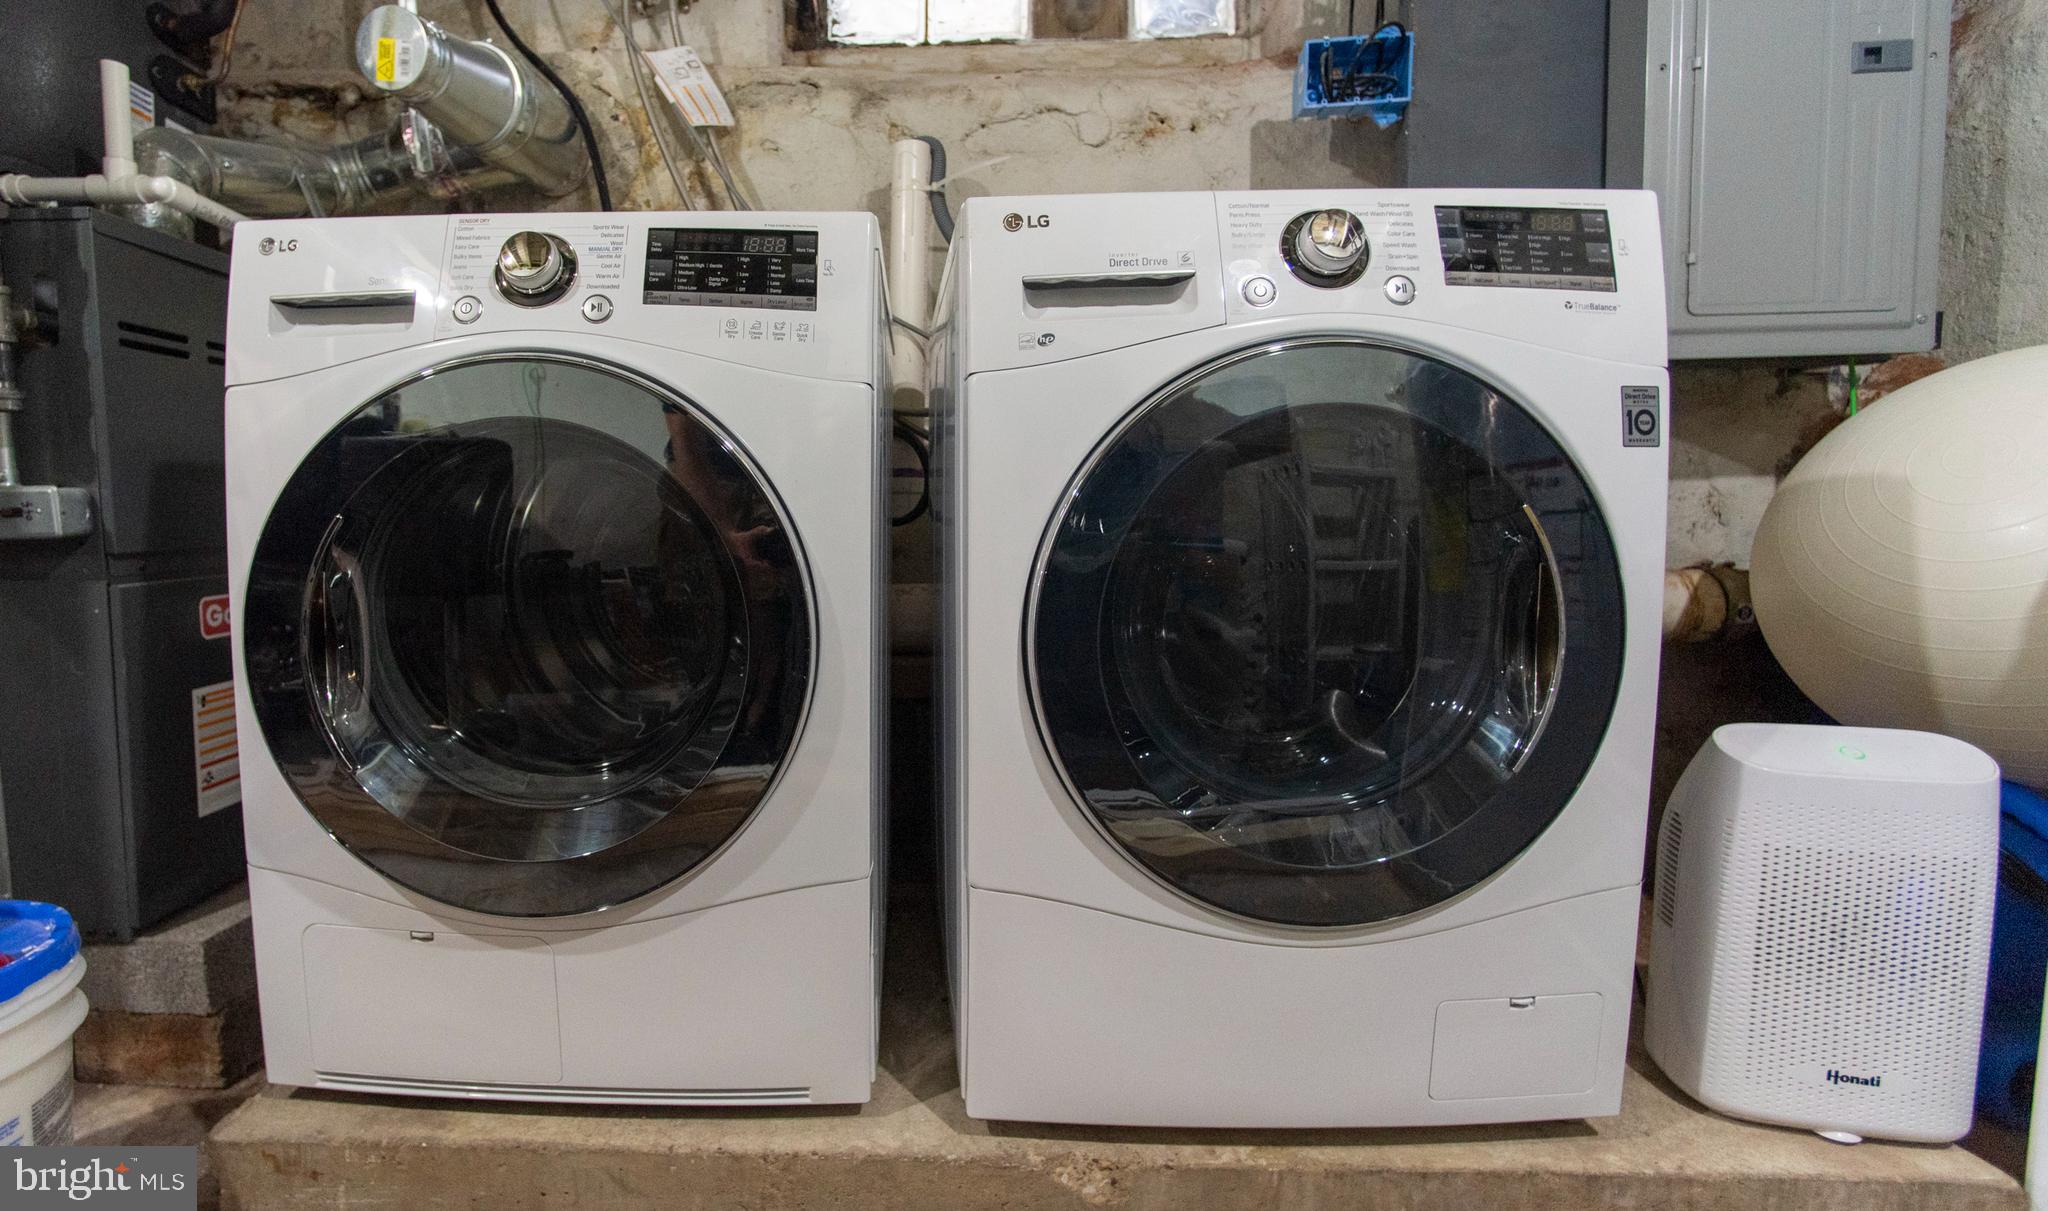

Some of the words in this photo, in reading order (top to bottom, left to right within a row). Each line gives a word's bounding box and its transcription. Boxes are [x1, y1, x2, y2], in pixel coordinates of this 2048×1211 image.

[1027, 215, 1049, 228] LG
[279, 240, 298, 252] LG
[1109, 258, 1139, 267] Direct
[1142, 257, 1168, 266] Drive
[1575, 302, 1617, 311] TrueBalance
[1626, 409, 1655, 435] 10
[1826, 1069, 1880, 1087] Honati
